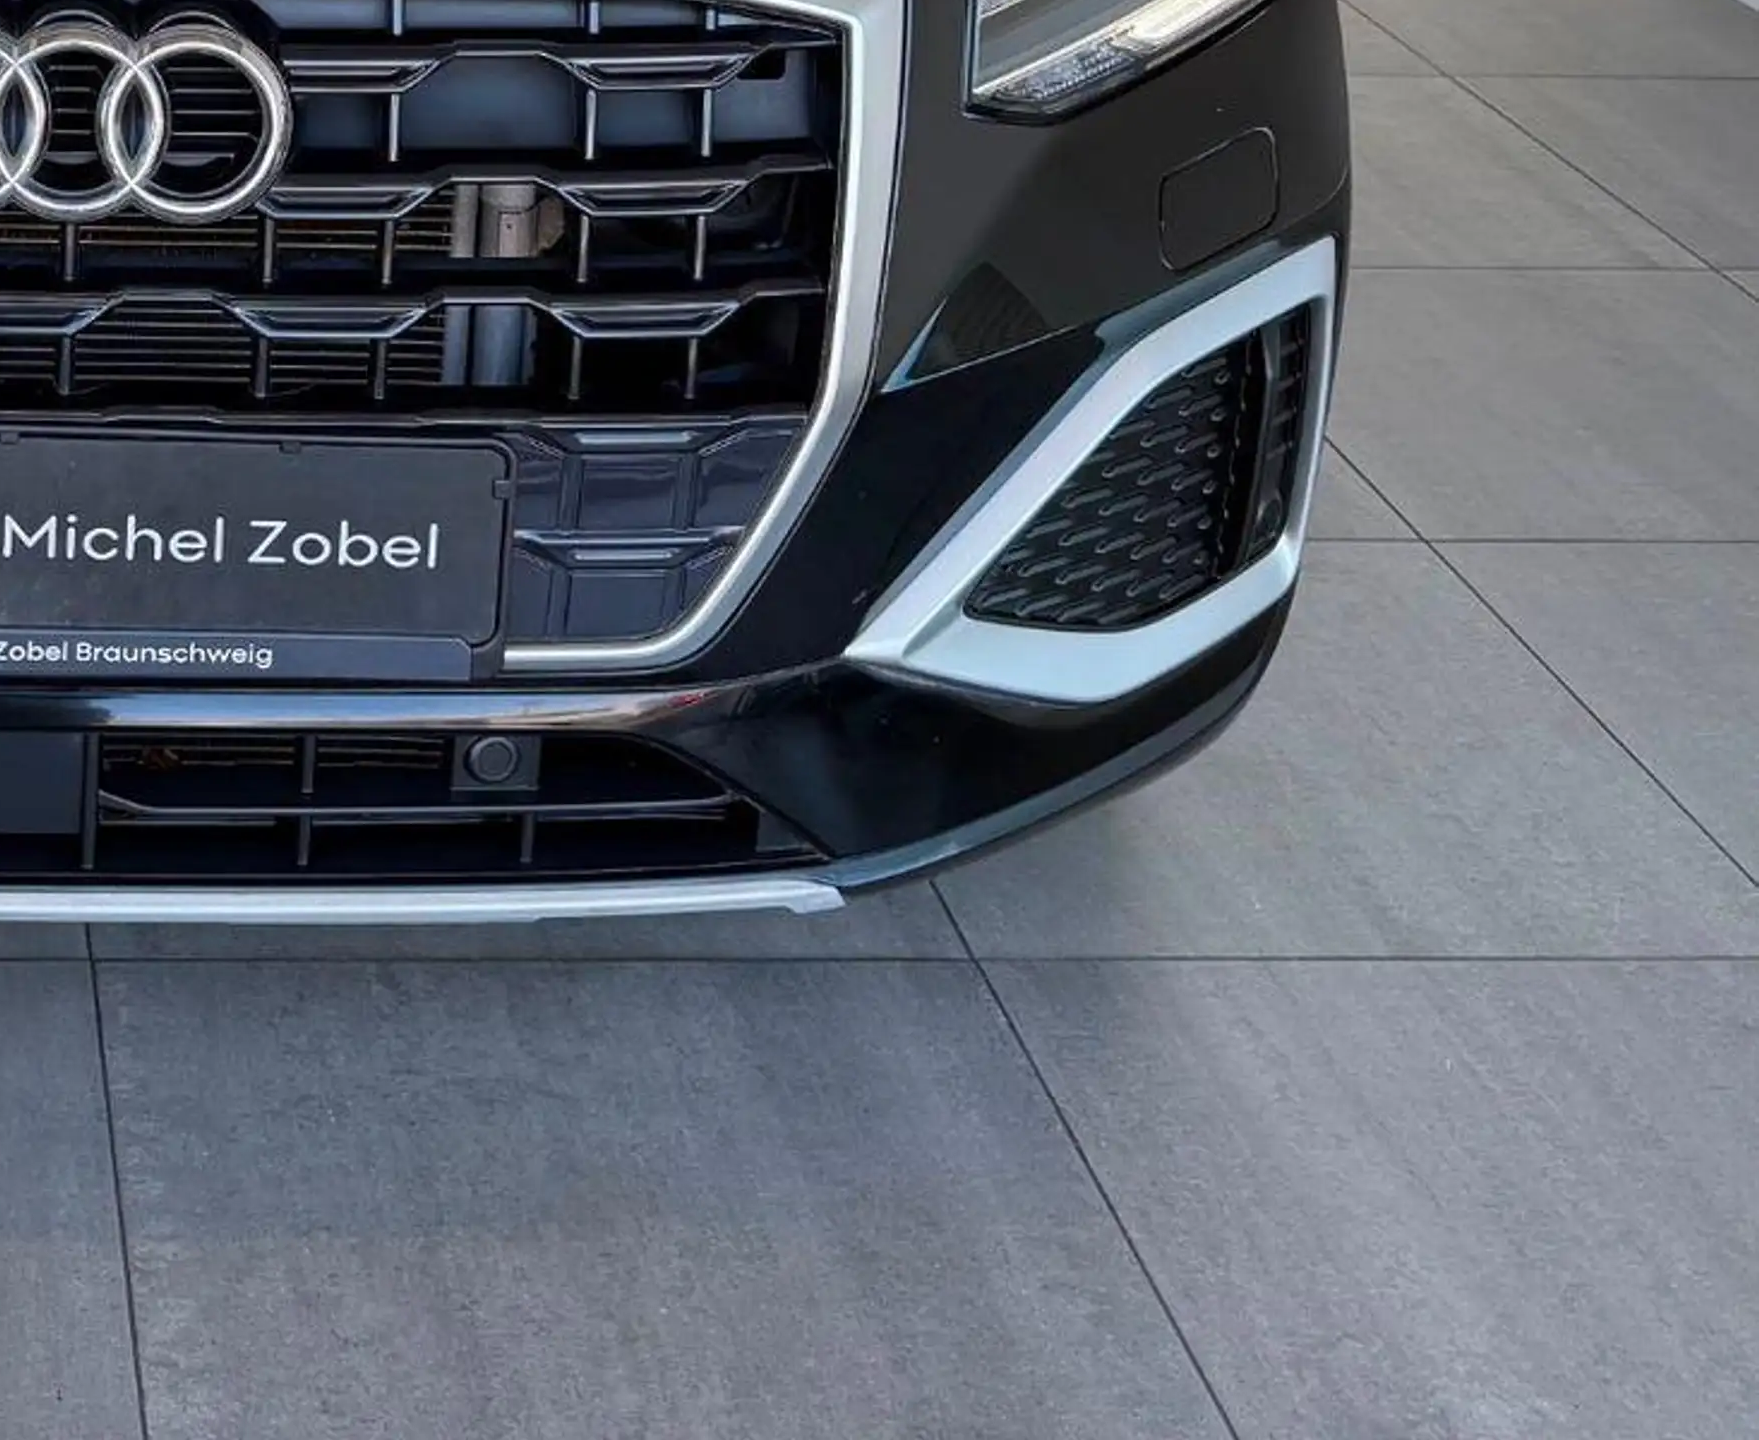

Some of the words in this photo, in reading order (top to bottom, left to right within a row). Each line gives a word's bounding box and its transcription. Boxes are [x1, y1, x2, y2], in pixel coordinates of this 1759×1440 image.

[2, 514, 225, 563] Michel
[247, 520, 439, 569] Zobel
[76, 641, 274, 670] Braunschweig
